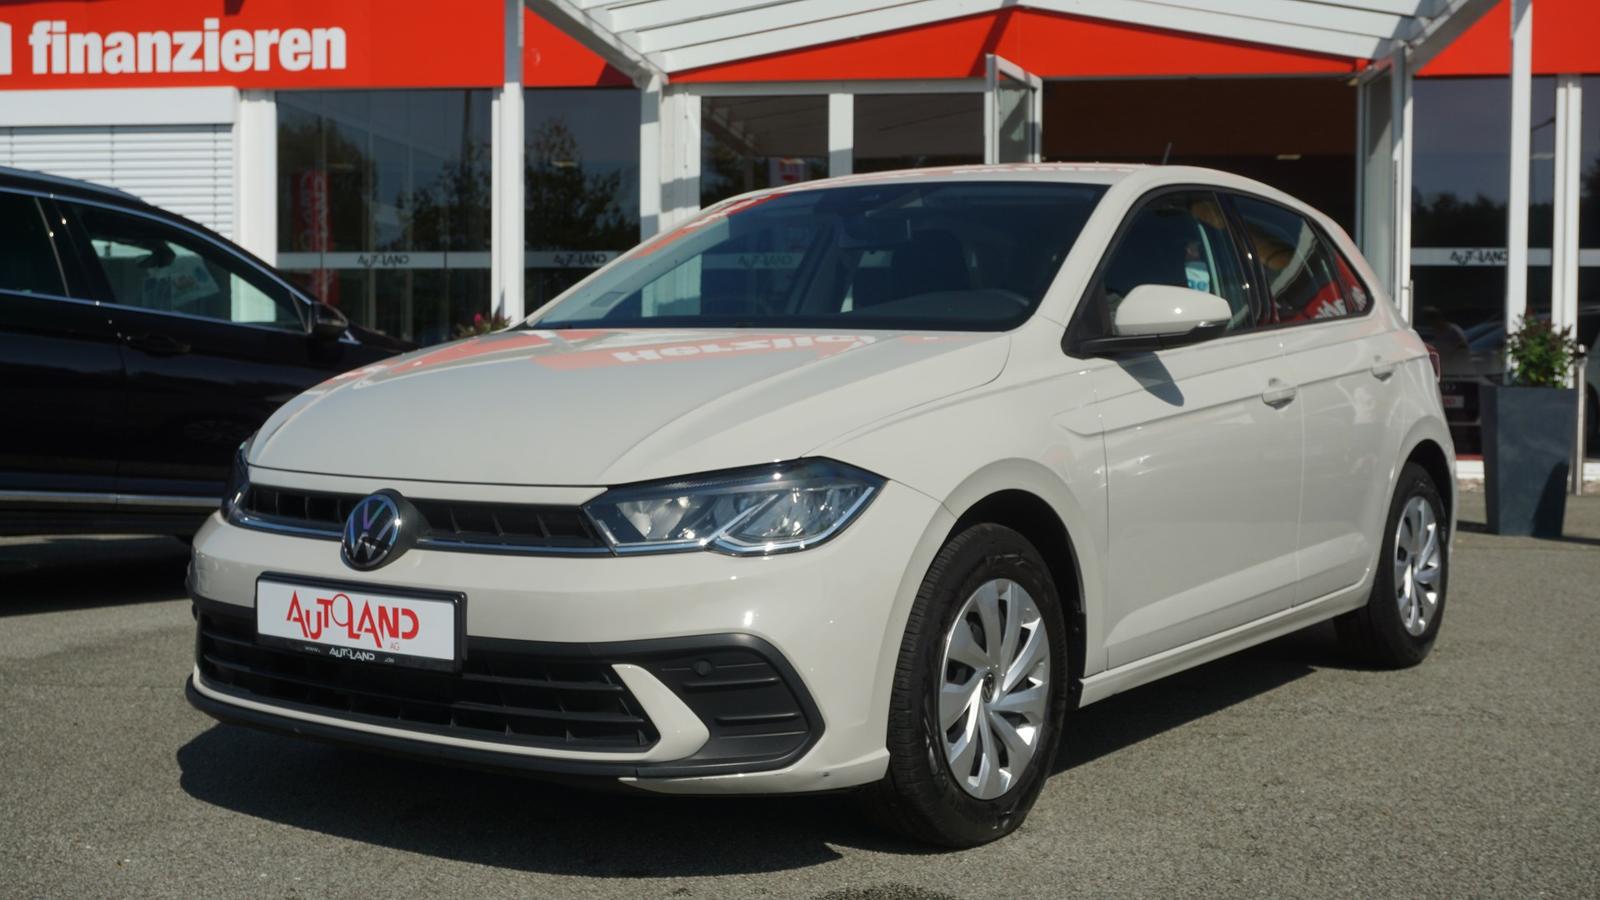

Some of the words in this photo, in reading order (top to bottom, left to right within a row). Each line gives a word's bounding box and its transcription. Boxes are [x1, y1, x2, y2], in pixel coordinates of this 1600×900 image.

[28, 18, 347, 75] finanzieren
[286, 590, 420, 649] AUTOLAND
[329, 647, 375, 661] AUTOLAND
